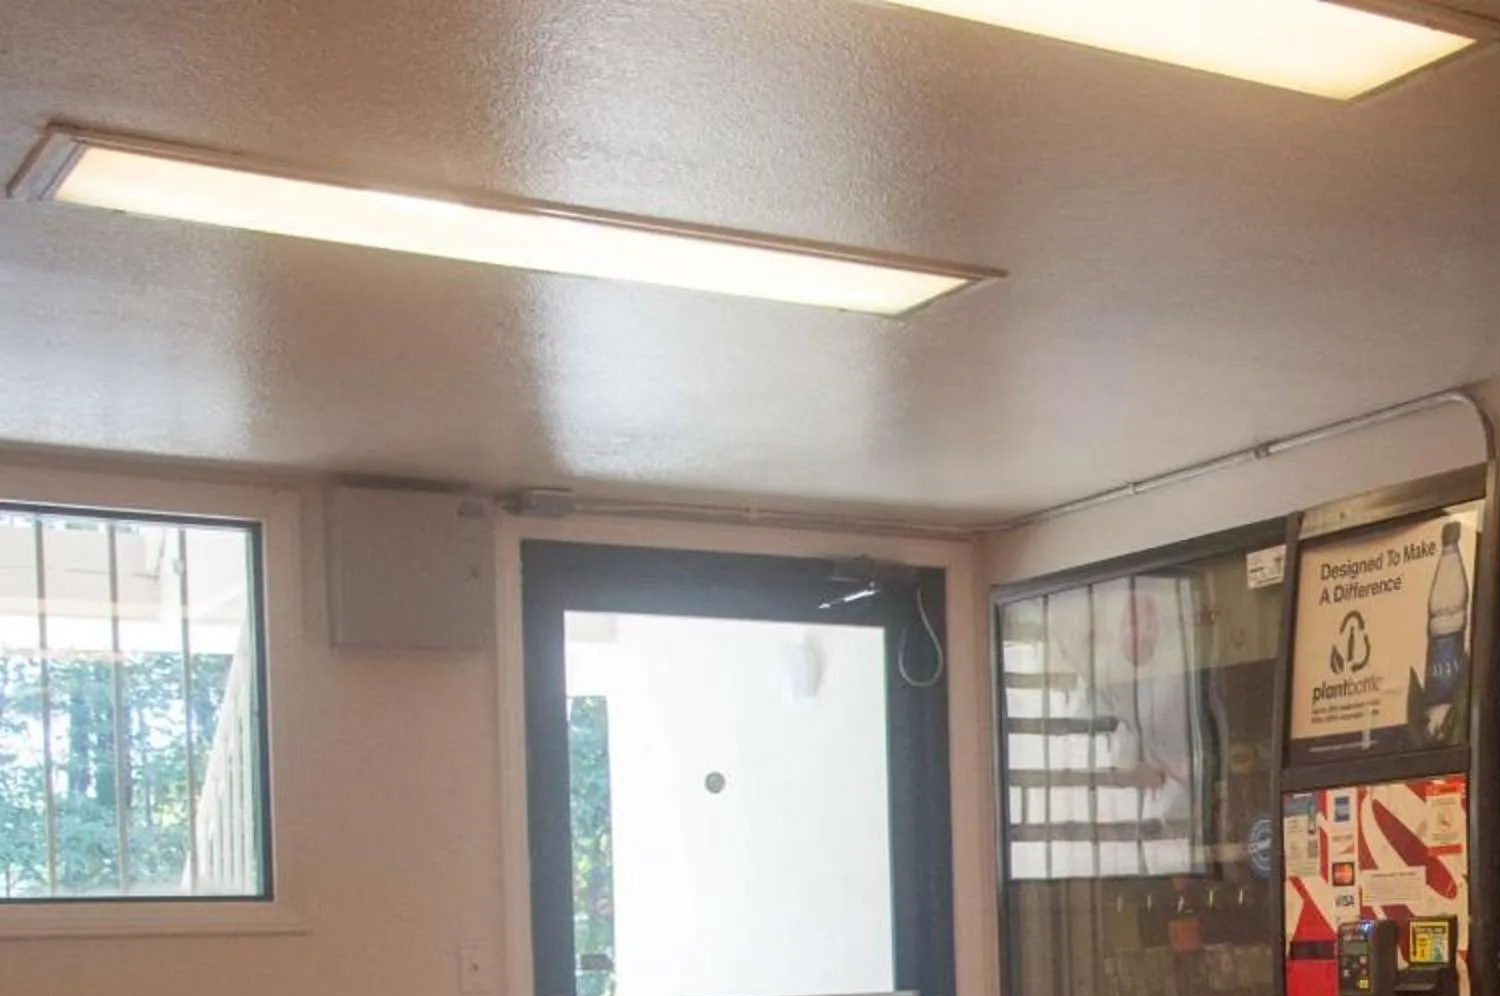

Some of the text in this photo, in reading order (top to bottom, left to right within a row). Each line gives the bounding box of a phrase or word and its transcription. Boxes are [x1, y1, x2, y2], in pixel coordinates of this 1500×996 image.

[1320, 541, 1437, 580] Designed To Make
[1320, 576, 1403, 605] A Difference
